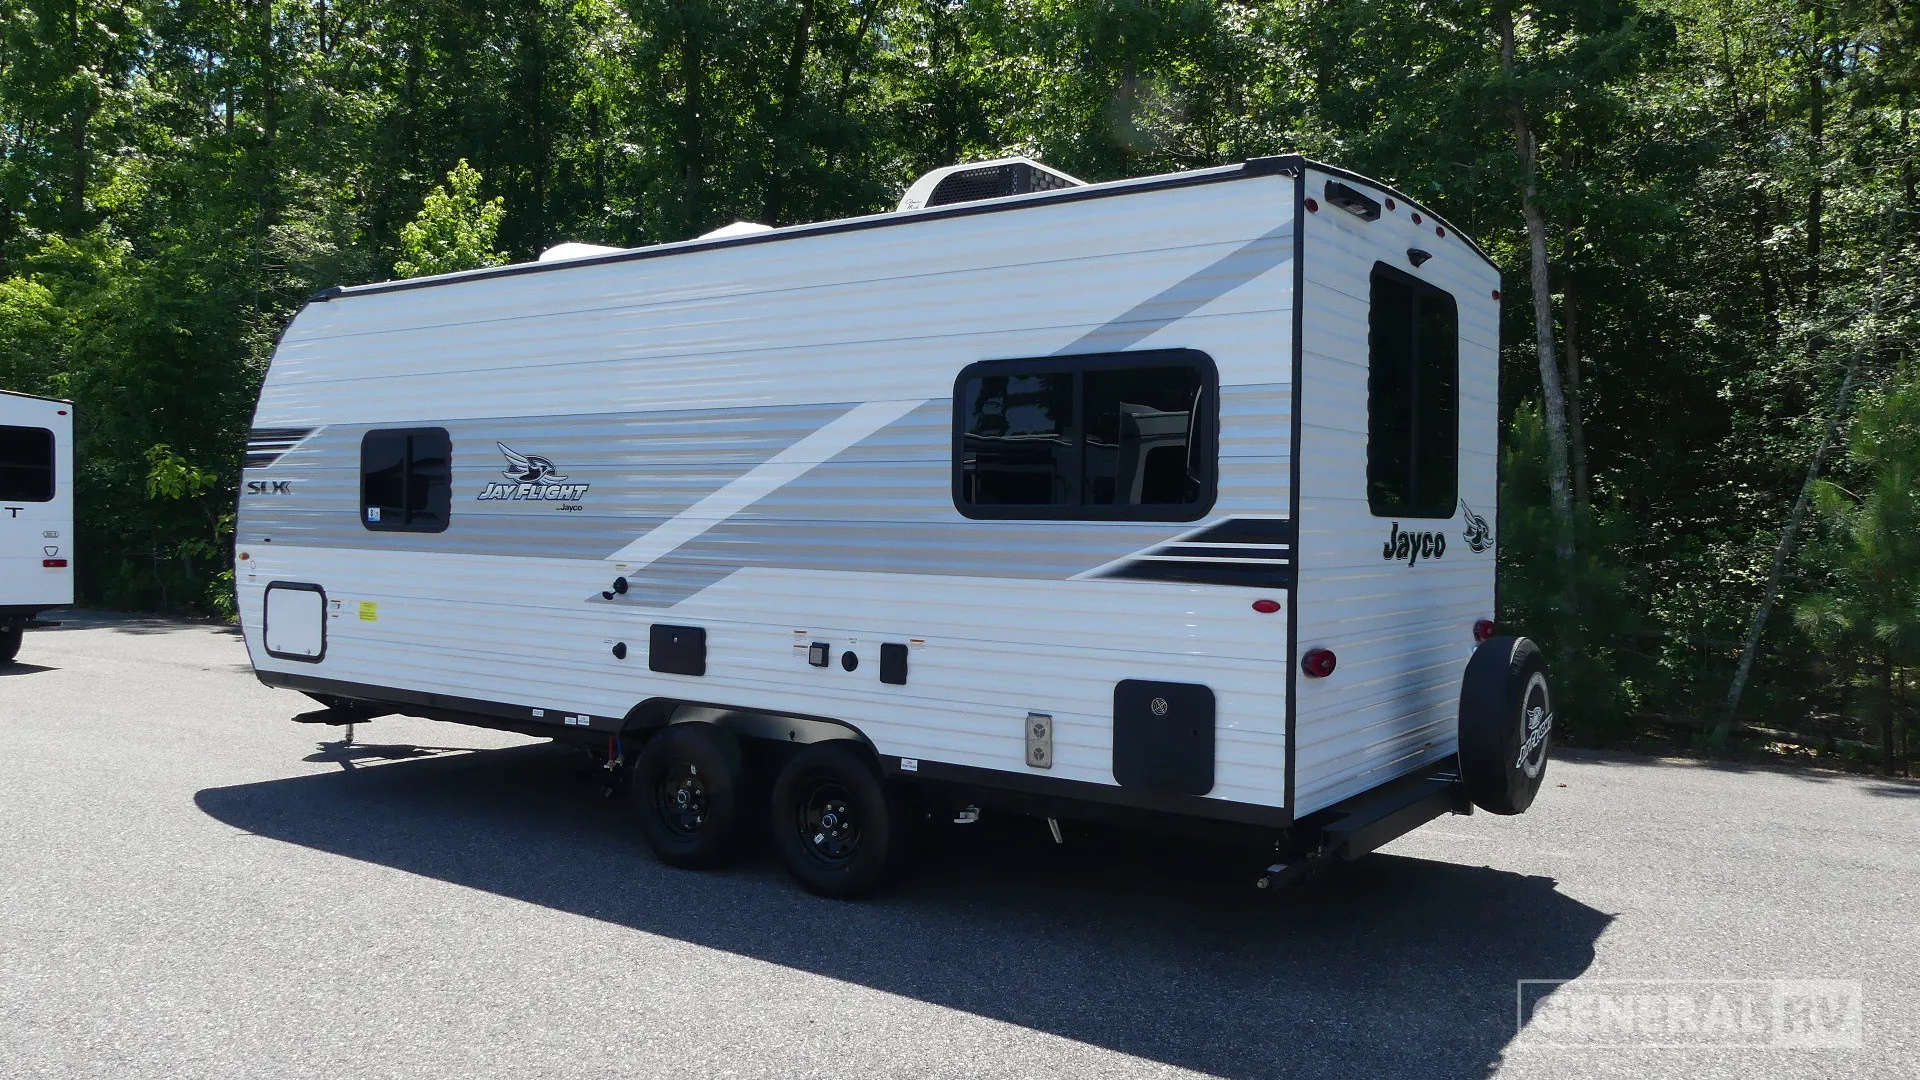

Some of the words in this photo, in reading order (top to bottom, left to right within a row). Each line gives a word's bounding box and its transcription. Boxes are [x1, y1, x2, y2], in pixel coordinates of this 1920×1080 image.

[477, 482, 518, 501] JAY
[514, 483, 591, 501] FLIGHT
[561, 503, 583, 513] Jayco
[1383, 521, 1446, 568] Jayco
